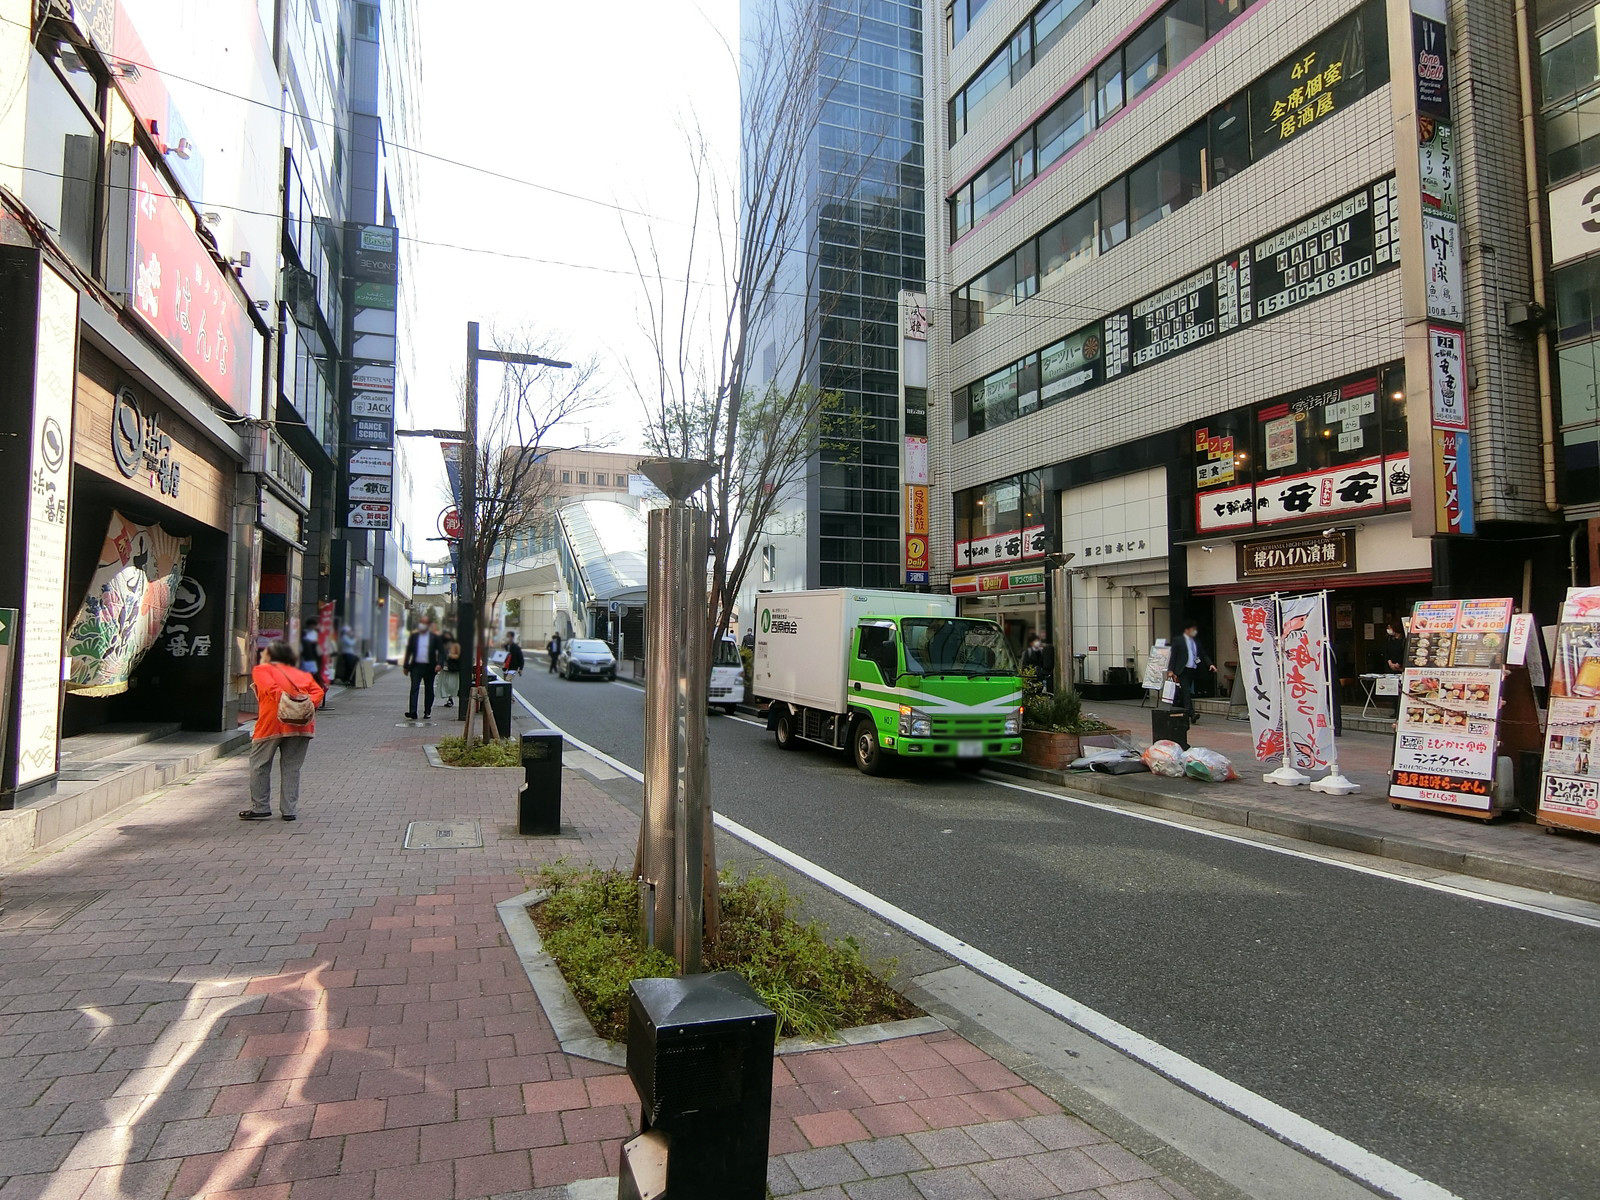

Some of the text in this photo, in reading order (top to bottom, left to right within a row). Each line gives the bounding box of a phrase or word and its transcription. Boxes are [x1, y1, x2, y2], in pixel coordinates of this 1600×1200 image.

[1291, 51, 1316, 80] 4F
[1419, 50, 1440, 67] tone
[1425, 63, 1444, 81] bell
[1270, 61, 1342, 122] 全席個室
[1280, 91, 1335, 140] 居酒屋
[1438, 126, 1451, 138] 3F
[1426, 149, 1434, 176] ダーツ
[1439, 138, 1453, 212] ビアポンバー
[141, 182, 157, 220] 2F
[1376, 184, 1387, 261] やってます
[1423, 217, 1434, 230] 3F
[1277, 223, 1349, 270] HAPPY
[360, 259, 397, 271] BEYOND
[1285, 247, 1342, 287] HOUR
[1258, 257, 1371, 316] 15:00-18:00
[1146, 293, 1198, 330] HAPPY
[1151, 312, 1195, 343] HOUR
[1134, 321, 1214, 364] 15:00-18:00
[1440, 336, 1452, 349] 2F
[1043, 347, 1081, 371] ダーツバー
[367, 402, 392, 413] JACK
[1327, 400, 1372, 417] 11時30分
[358, 421, 383, 431] DANCE
[1344, 420, 1358, 430] から
[358, 430, 387, 439] SCHOOL
[1198, 432, 1231, 452] ランチ
[1340, 435, 1360, 444] 23時
[1198, 465, 1220, 480] 定食
[1442, 453, 1465, 527] ラーメン
[914, 489, 926, 531] 鳥貴族
[906, 558, 926, 569] Daily
[910, 572, 925, 582] 酒
[983, 575, 1003, 591] Daily
[770, 620, 798, 635] 西原商会
[1428, 622, 1454, 630] 140円
[1476, 621, 1504, 629] 140円
[166, 623, 212, 658] 一番屋
[1426, 738, 1487, 754] えびかに食堂
